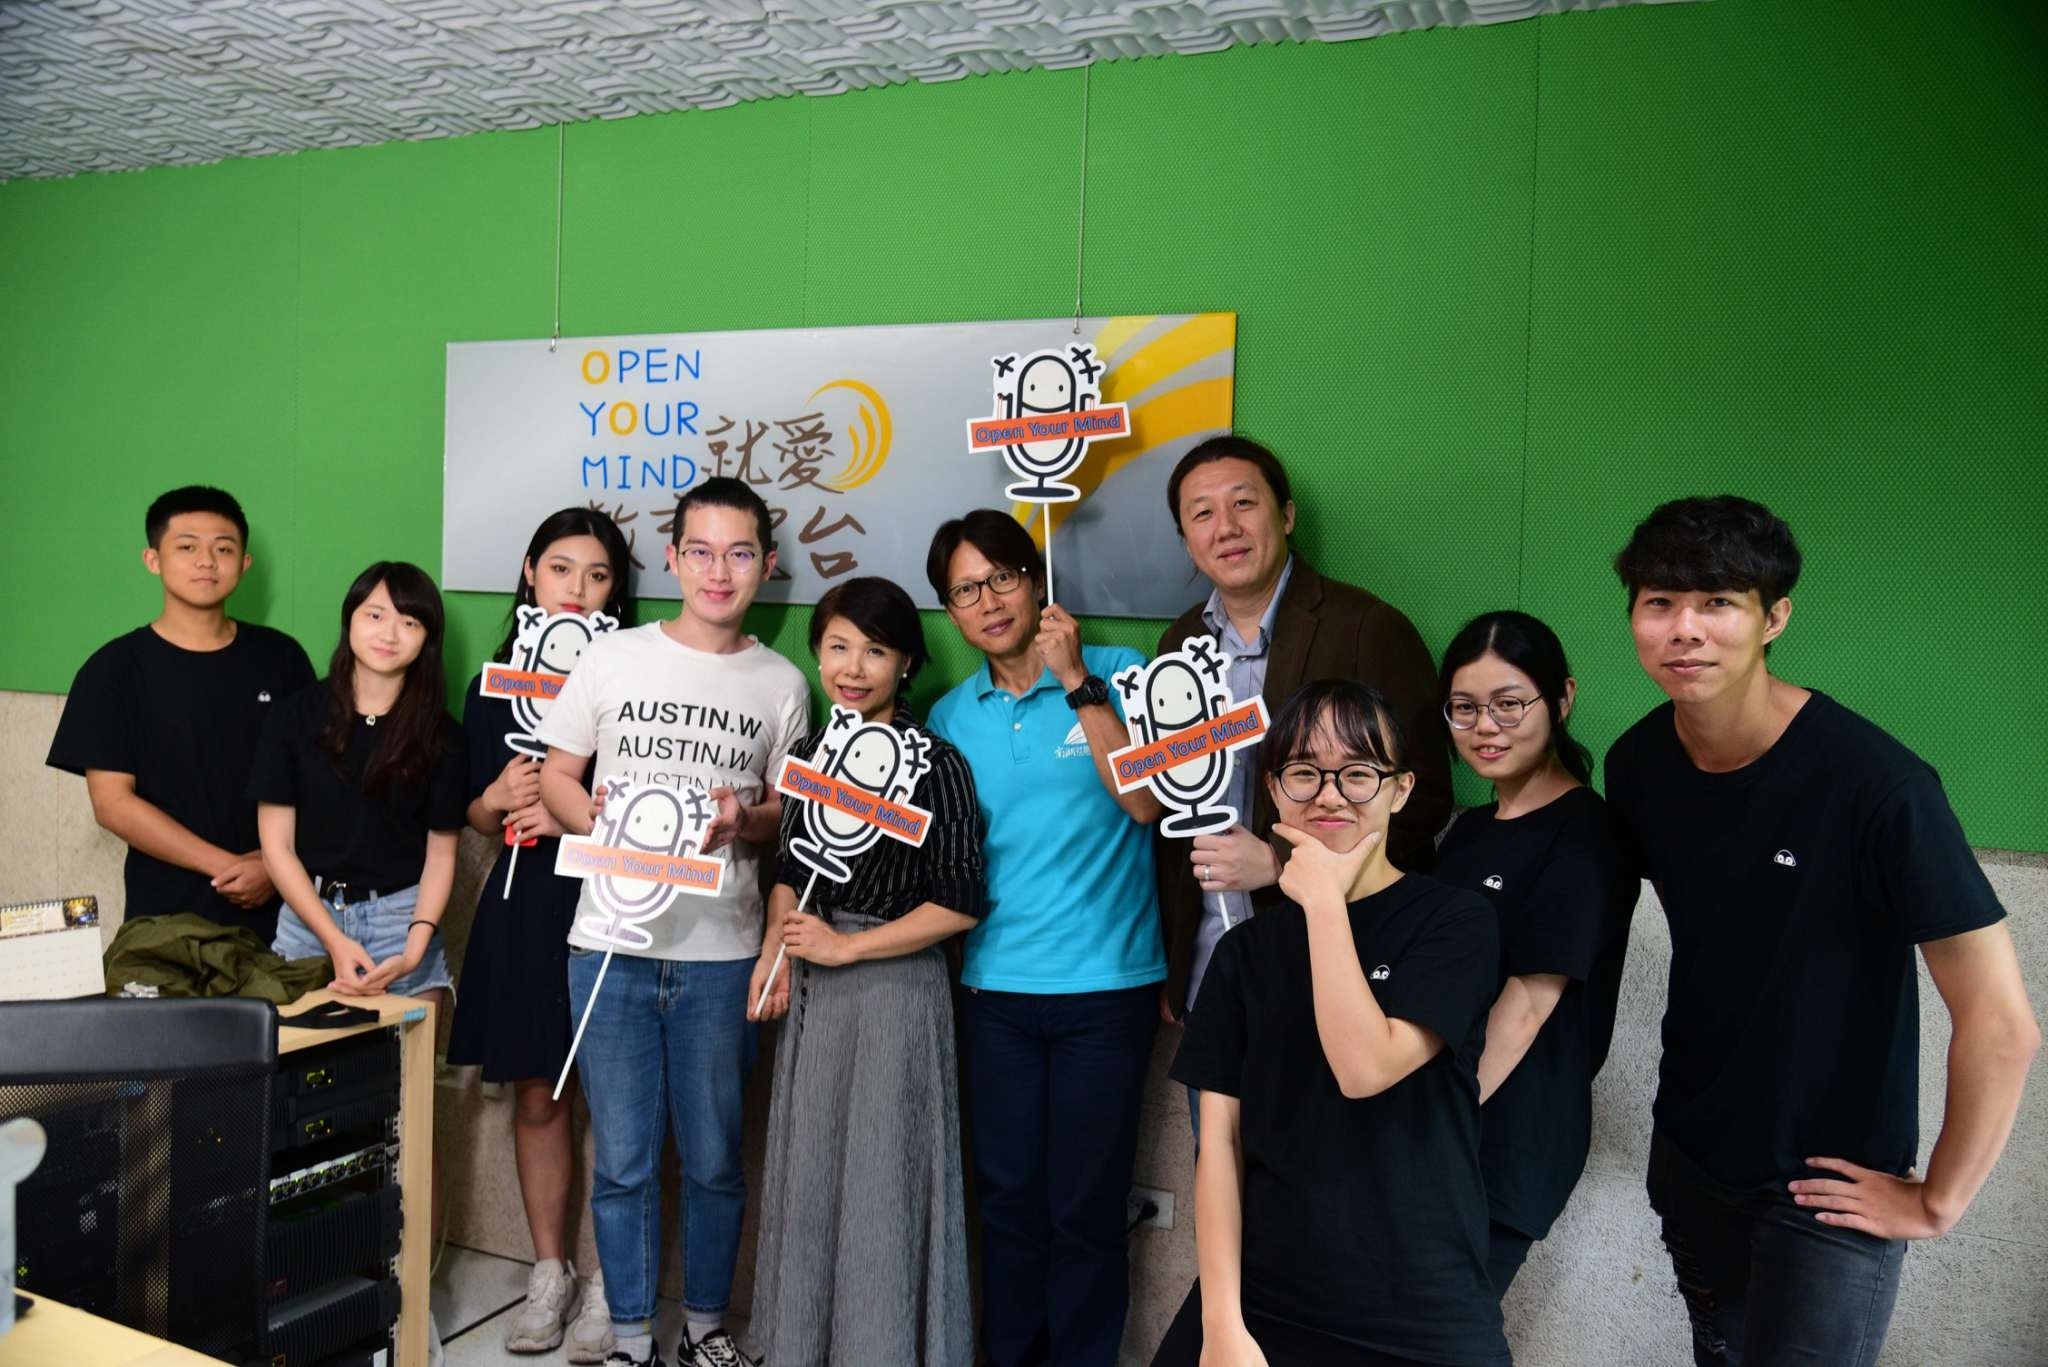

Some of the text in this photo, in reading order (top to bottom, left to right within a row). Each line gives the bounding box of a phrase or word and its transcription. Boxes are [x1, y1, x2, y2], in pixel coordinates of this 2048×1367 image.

[581, 348, 700, 385] OPEN
[579, 400, 699, 436] YOUR
[976, 412, 1121, 444] Open Your Mind
[701, 412, 844, 494] 就愛
[581, 454, 696, 490] MIND
[490, 672, 563, 695] Open Yo
[617, 700, 762, 740] AUSTIN.W
[617, 735, 753, 771] AUSTIN.W
[1119, 751, 1166, 777] Open
[1167, 734, 1207, 760] Your
[1210, 710, 1258, 744] Mind
[787, 769, 922, 835] Open Your Mind
[622, 855, 663, 874] Your
[667, 863, 715, 884] Mind
